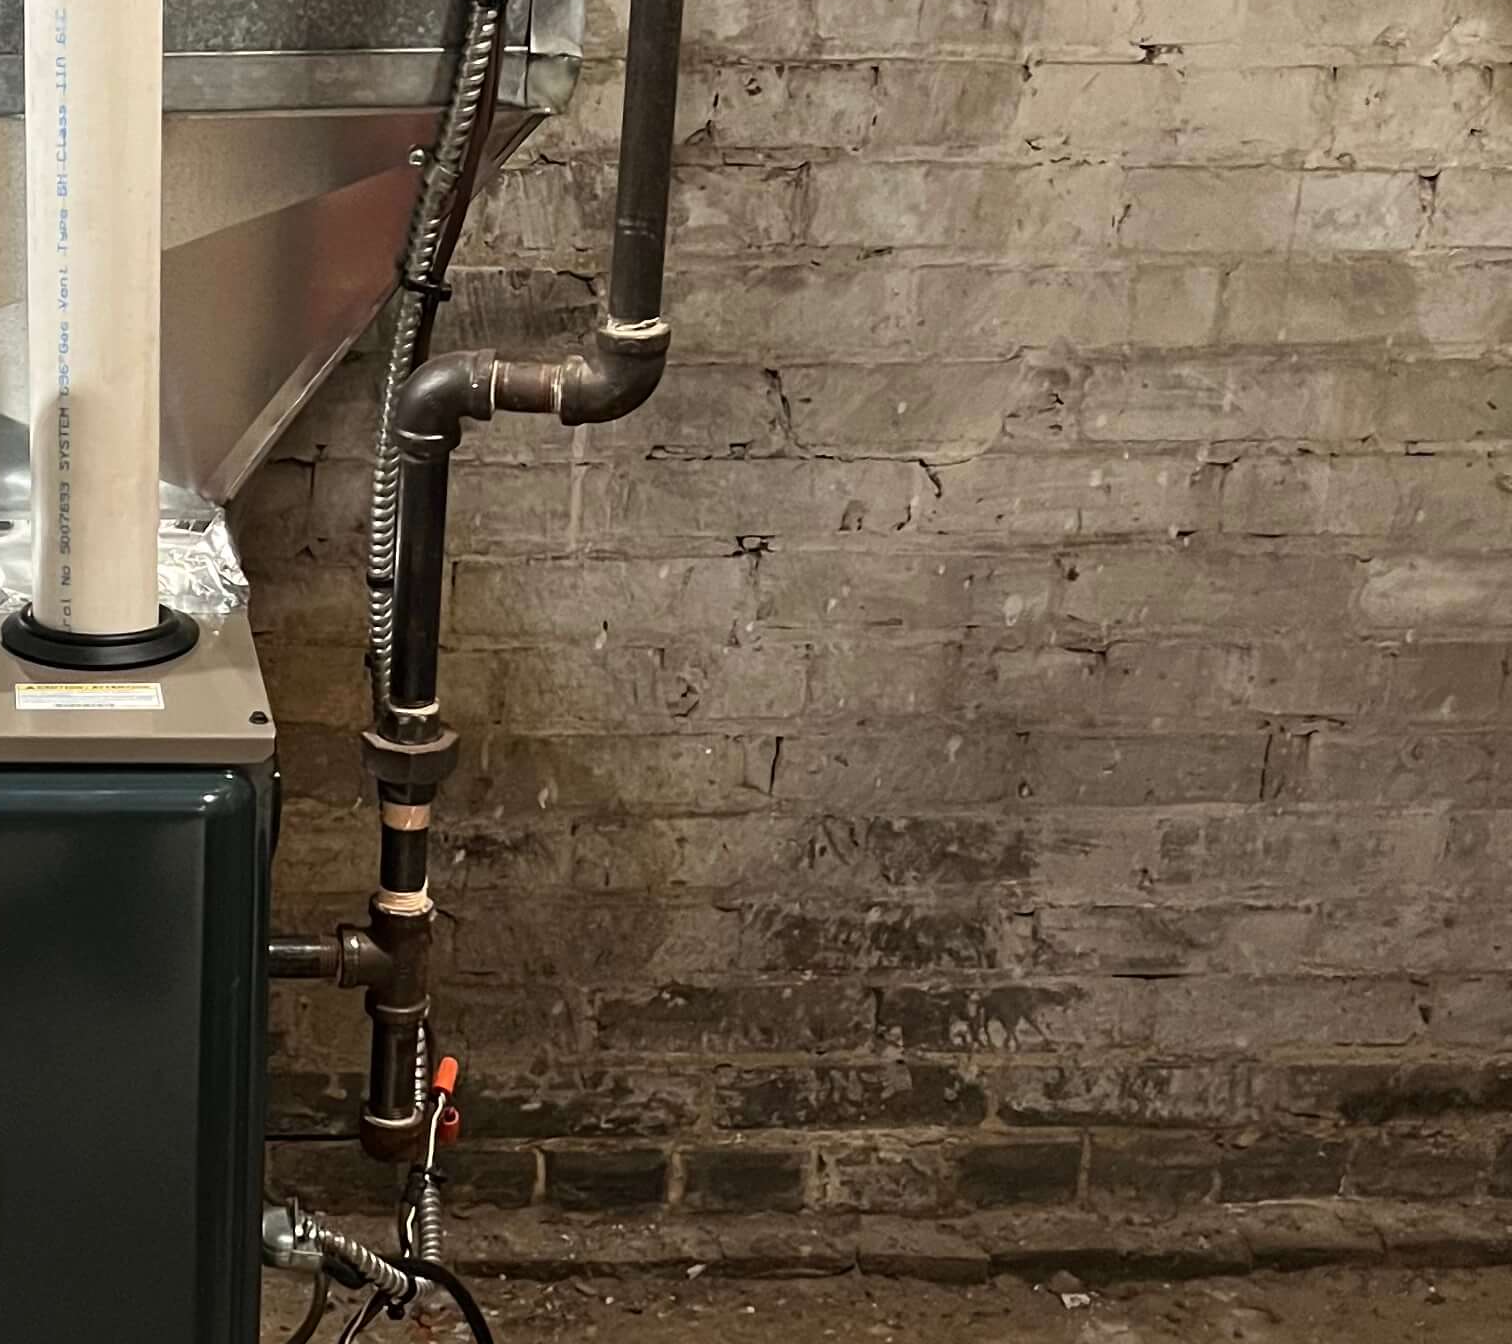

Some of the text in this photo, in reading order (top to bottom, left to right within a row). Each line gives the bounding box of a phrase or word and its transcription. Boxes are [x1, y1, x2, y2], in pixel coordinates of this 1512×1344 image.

[57, 207, 72, 253] Type
[57, 264, 70, 311] Vent
[58, 406, 71, 471] SYSTEM
